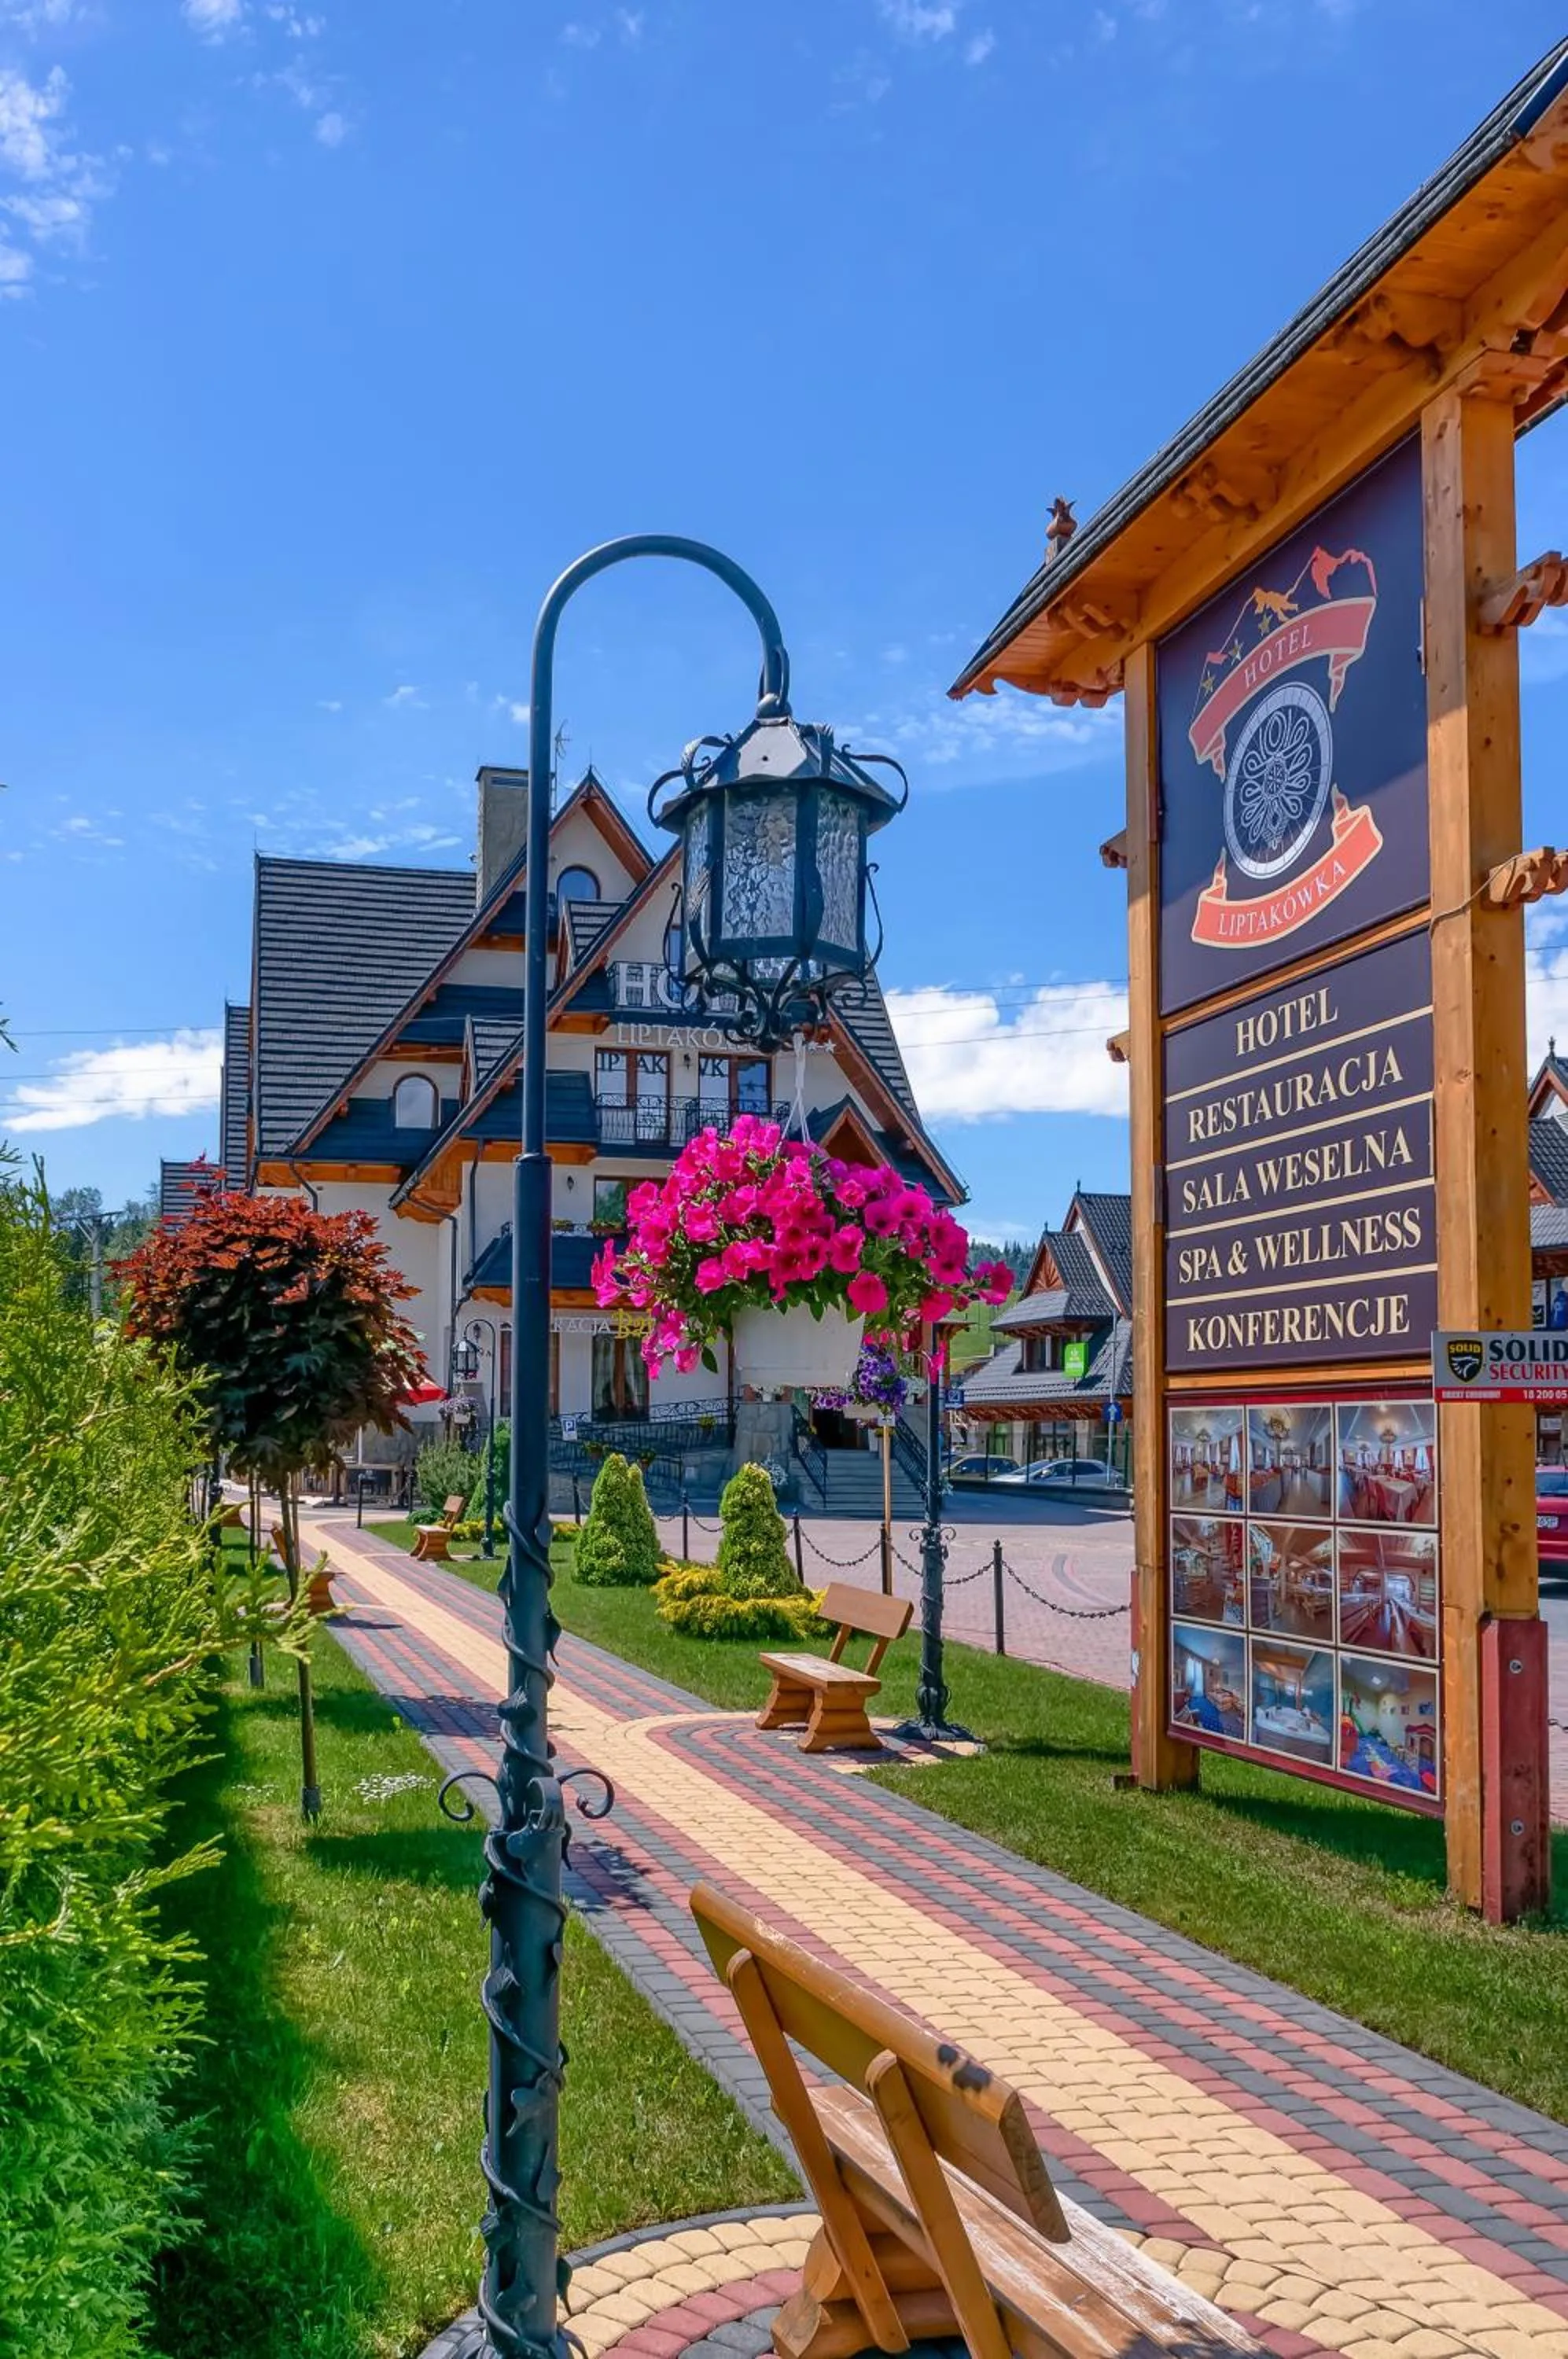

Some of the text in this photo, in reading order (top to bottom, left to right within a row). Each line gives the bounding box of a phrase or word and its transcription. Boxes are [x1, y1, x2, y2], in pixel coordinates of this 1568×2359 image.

[1244, 624, 1312, 689] HOTEL
[1216, 860, 1348, 937] LIPTAKÓWKA
[616, 1021, 761, 1052] LIPTAKÓ
[1235, 987, 1338, 1057] HOTEL
[1187, 1046, 1404, 1143] RESTAURACJA
[1182, 1126, 1413, 1214] SALA WESELNA
[1179, 1207, 1423, 1284] SPA & WELLNESS
[1186, 1294, 1411, 1352] KONFERENCJE
[1448, 1343, 1482, 1354] SOLID
[1489, 1339, 1568, 1362] SOLID
[1489, 1363, 1568, 1381] SECURITY
